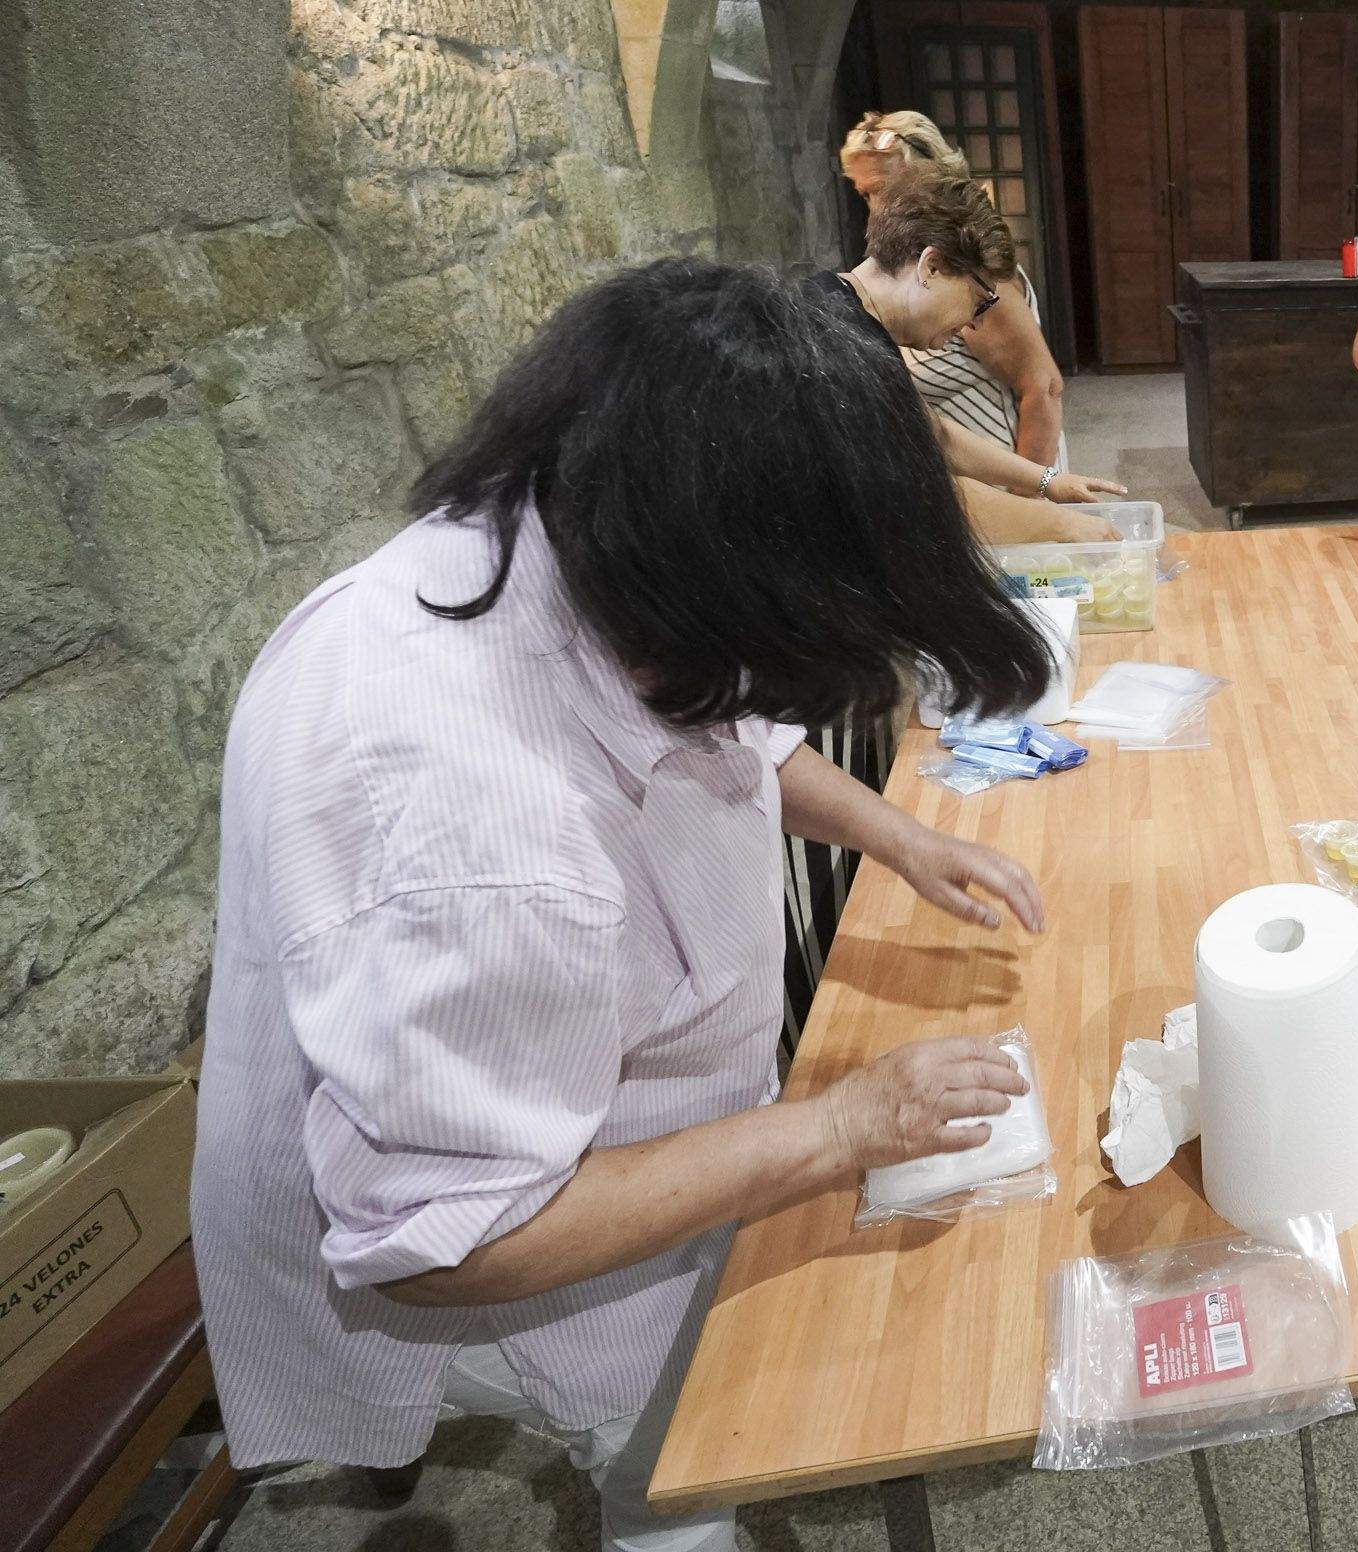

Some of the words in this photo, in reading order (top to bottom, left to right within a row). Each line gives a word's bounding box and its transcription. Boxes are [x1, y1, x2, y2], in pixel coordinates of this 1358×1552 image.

[0, 1293, 21, 1318] 24
[23, 1220, 103, 1292] VELONES
[32, 1261, 91, 1314] EXTRA
[1143, 1343, 1161, 1385] APLI
